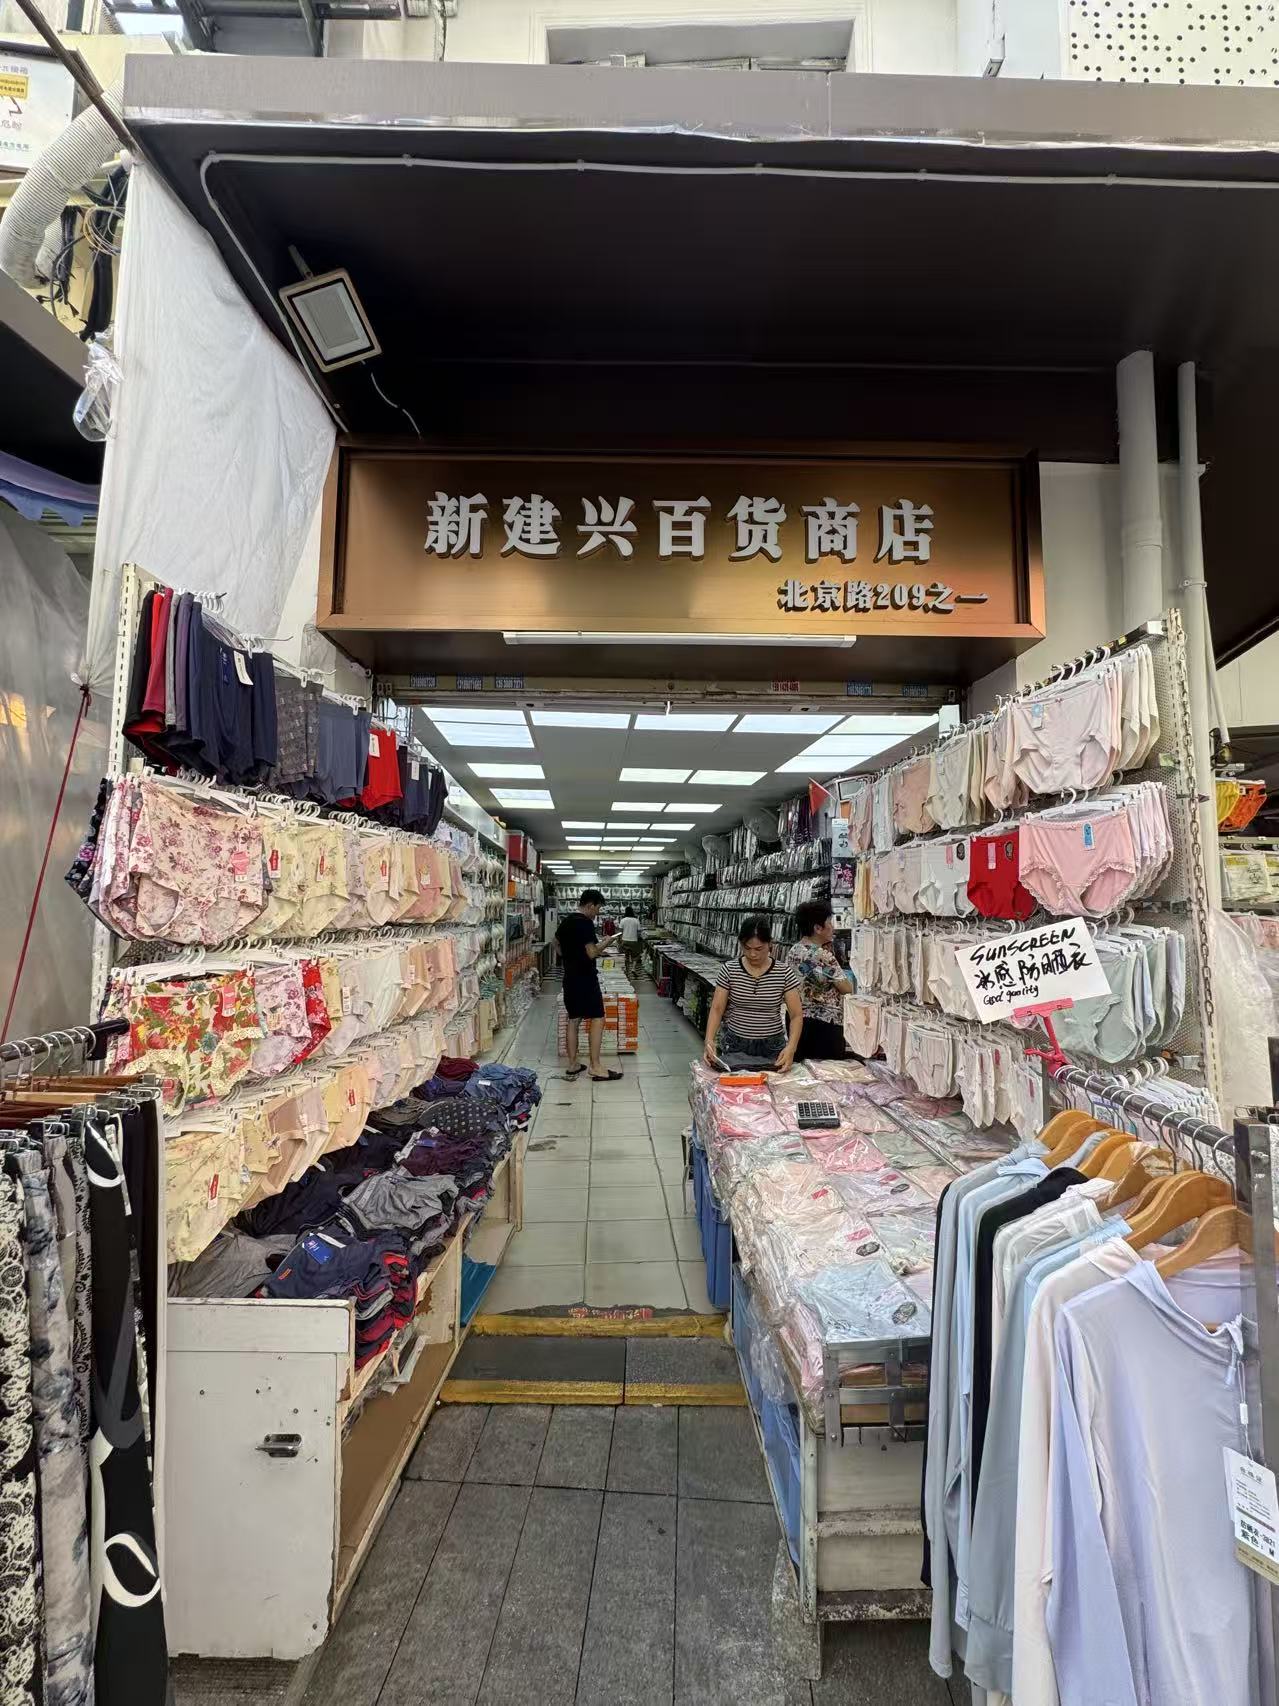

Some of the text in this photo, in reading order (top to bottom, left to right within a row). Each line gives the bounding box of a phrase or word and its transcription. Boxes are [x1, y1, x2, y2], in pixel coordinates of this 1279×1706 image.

[424, 491, 934, 564] 新建兴百货商店
[778, 579, 988, 614] 北京路209之一
[983, 984, 1039, 1006] Good quality
